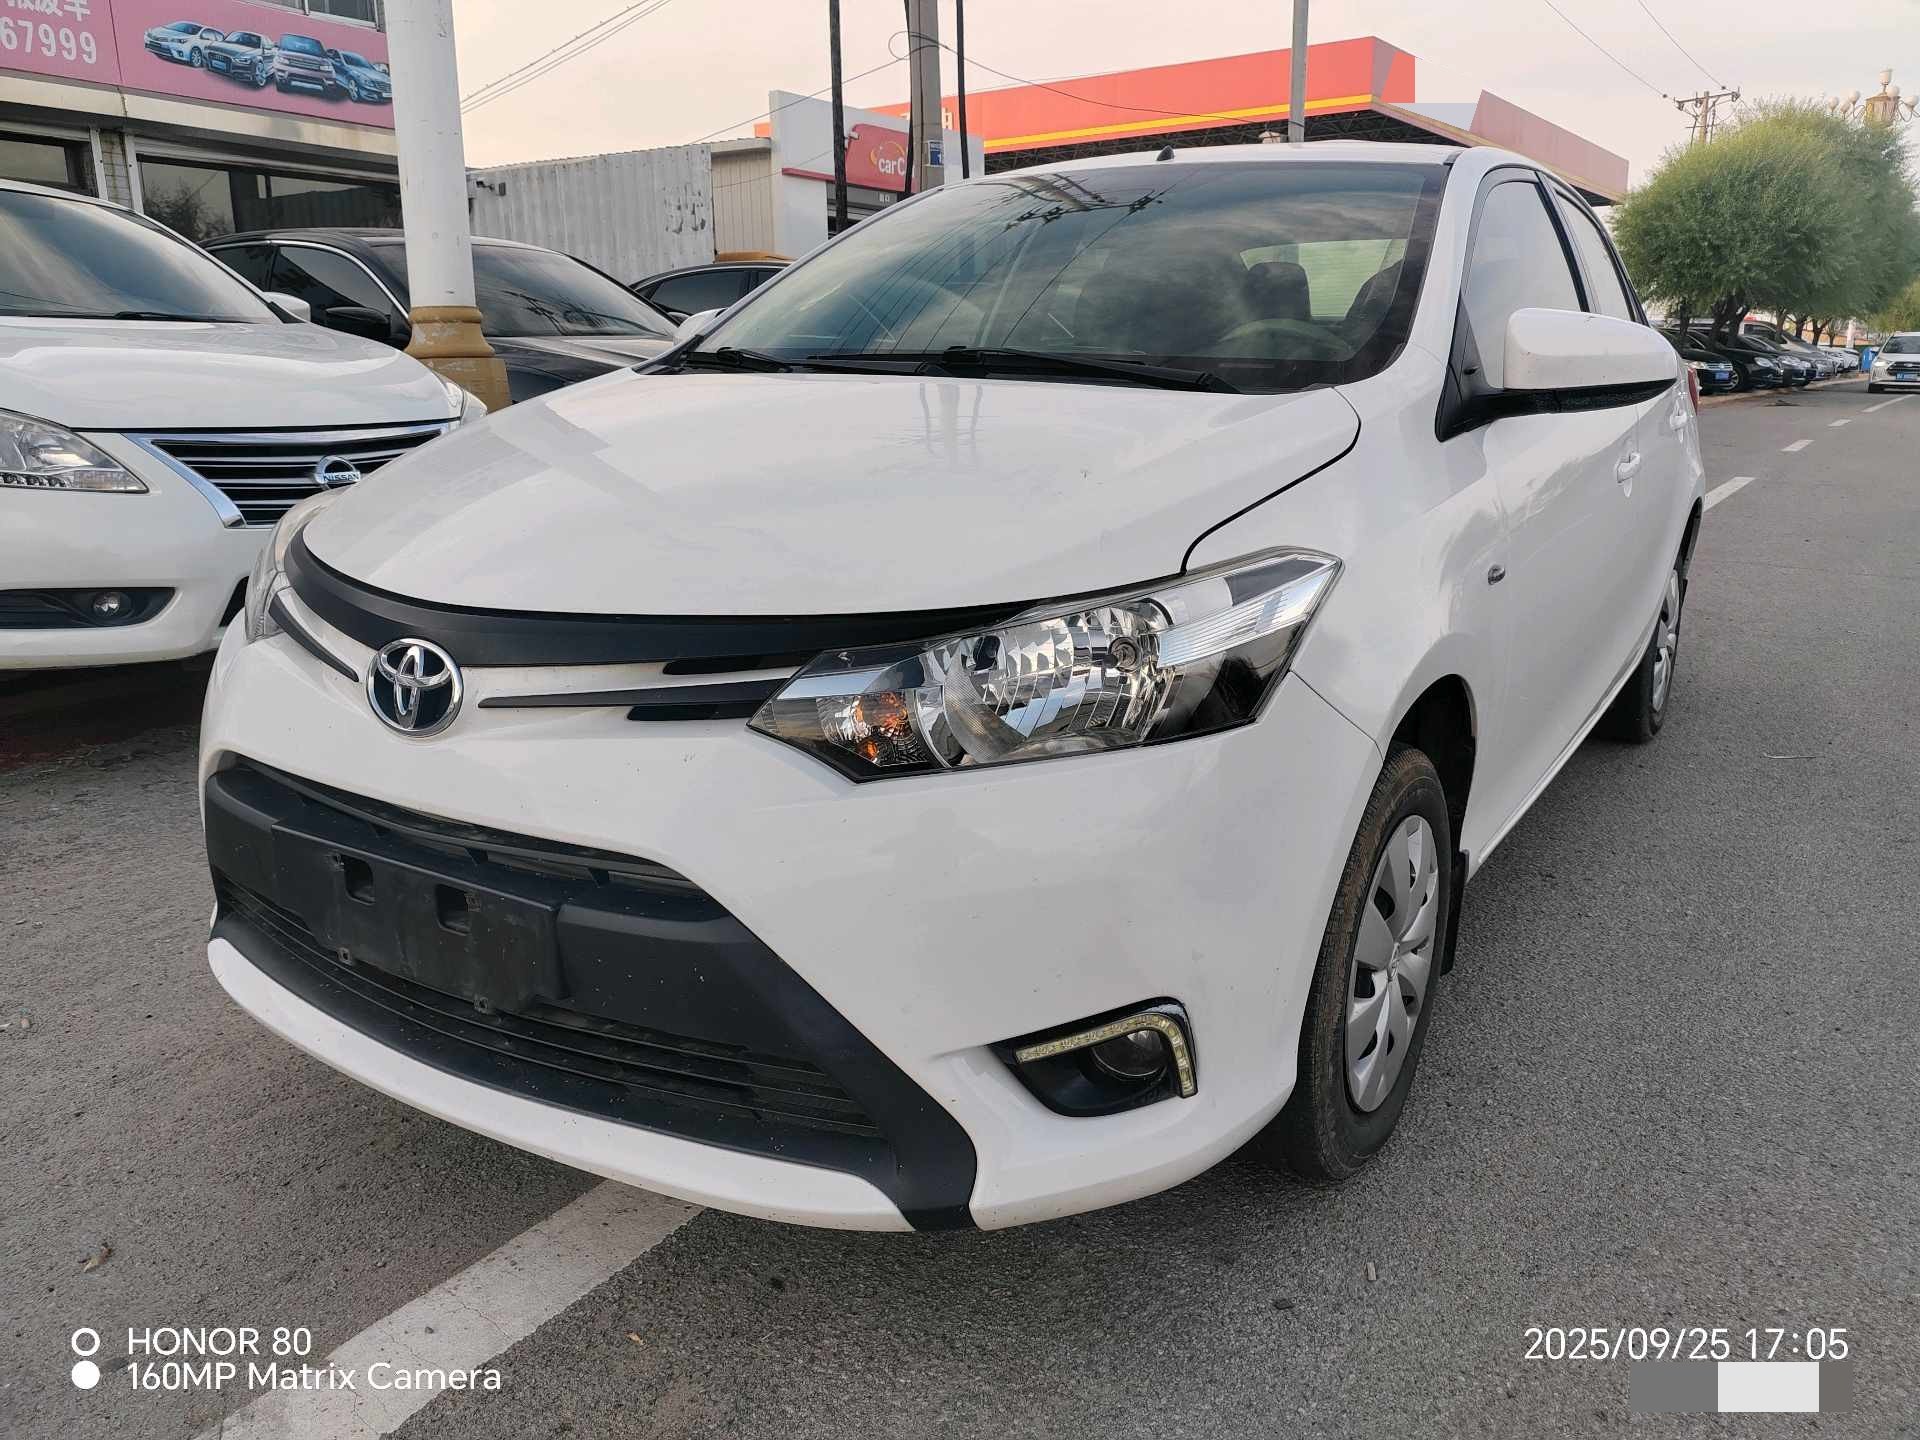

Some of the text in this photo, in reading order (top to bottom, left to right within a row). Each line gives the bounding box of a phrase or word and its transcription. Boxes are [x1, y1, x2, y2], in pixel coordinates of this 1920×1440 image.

[0, 16, 97, 64] 67999
[878, 157, 915, 177] carC
[322, 471, 361, 482] NISSAN
